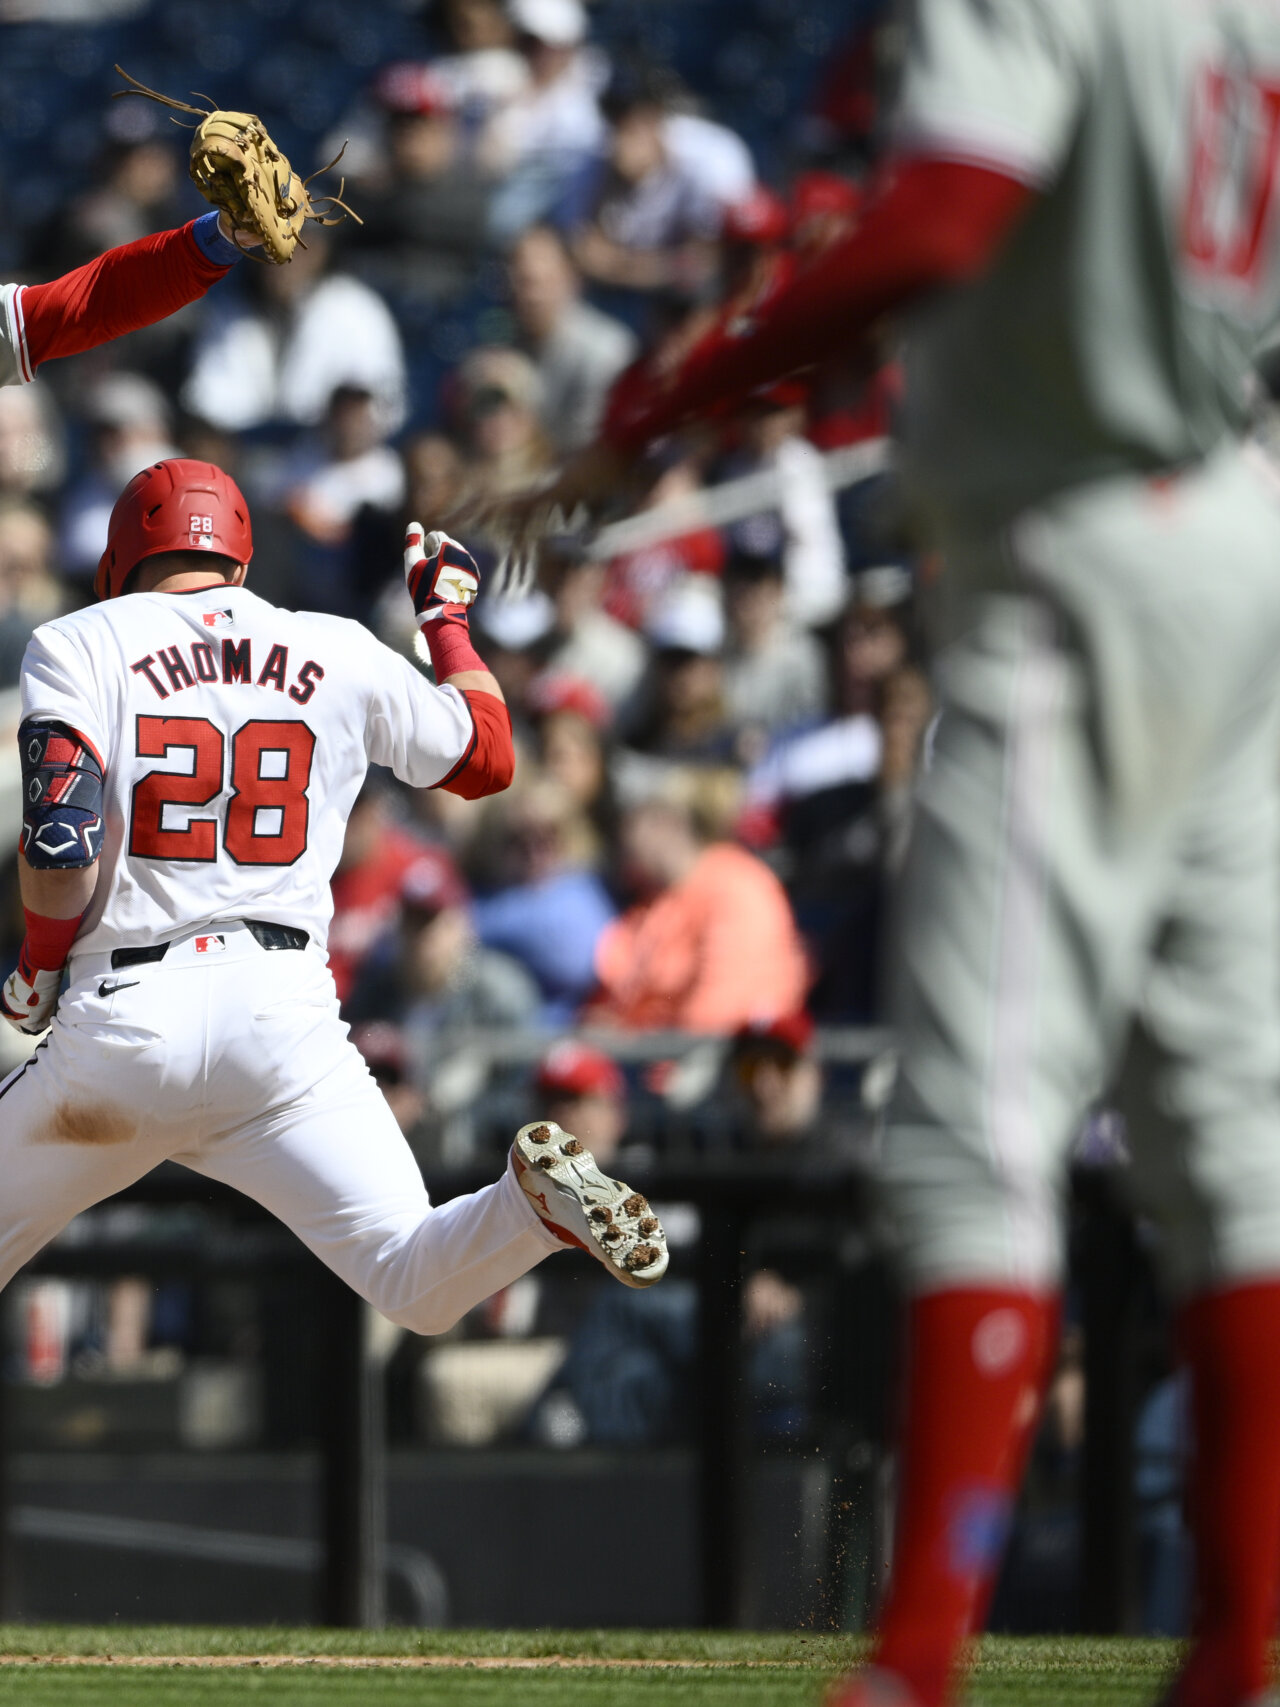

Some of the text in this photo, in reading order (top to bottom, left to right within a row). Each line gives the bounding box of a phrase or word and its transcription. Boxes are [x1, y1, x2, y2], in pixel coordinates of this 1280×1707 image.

[190, 516, 213, 532] 28
[130, 638, 325, 706] THOMAS
[128, 714, 317, 867] 28
